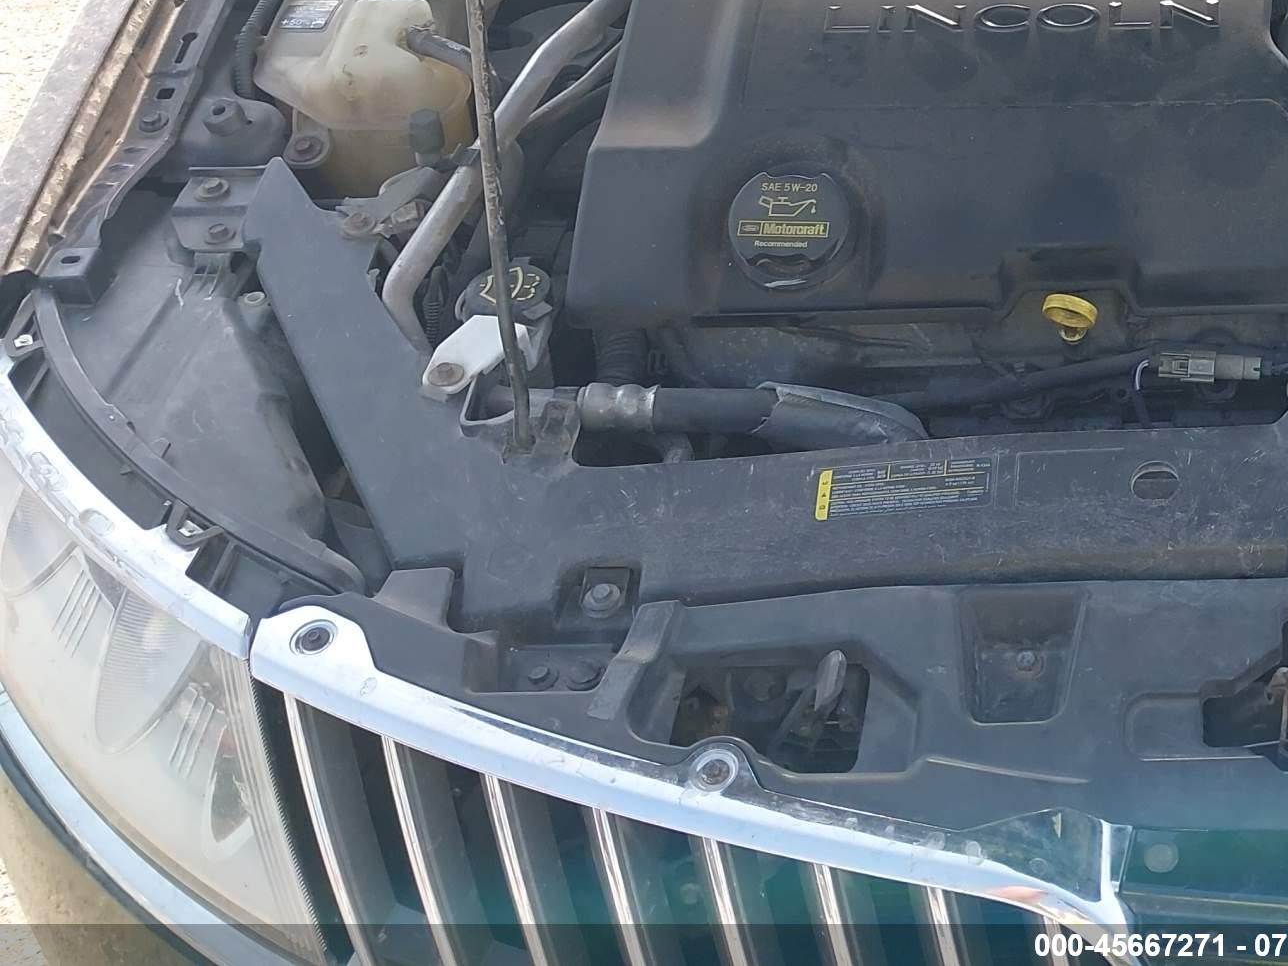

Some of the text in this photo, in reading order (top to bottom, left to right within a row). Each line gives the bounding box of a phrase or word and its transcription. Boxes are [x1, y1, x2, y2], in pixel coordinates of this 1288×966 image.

[761, 182, 818, 192] SAE 5W-20
[763, 222, 826, 235] Motorcraft
[754, 240, 808, 248] Recommended
